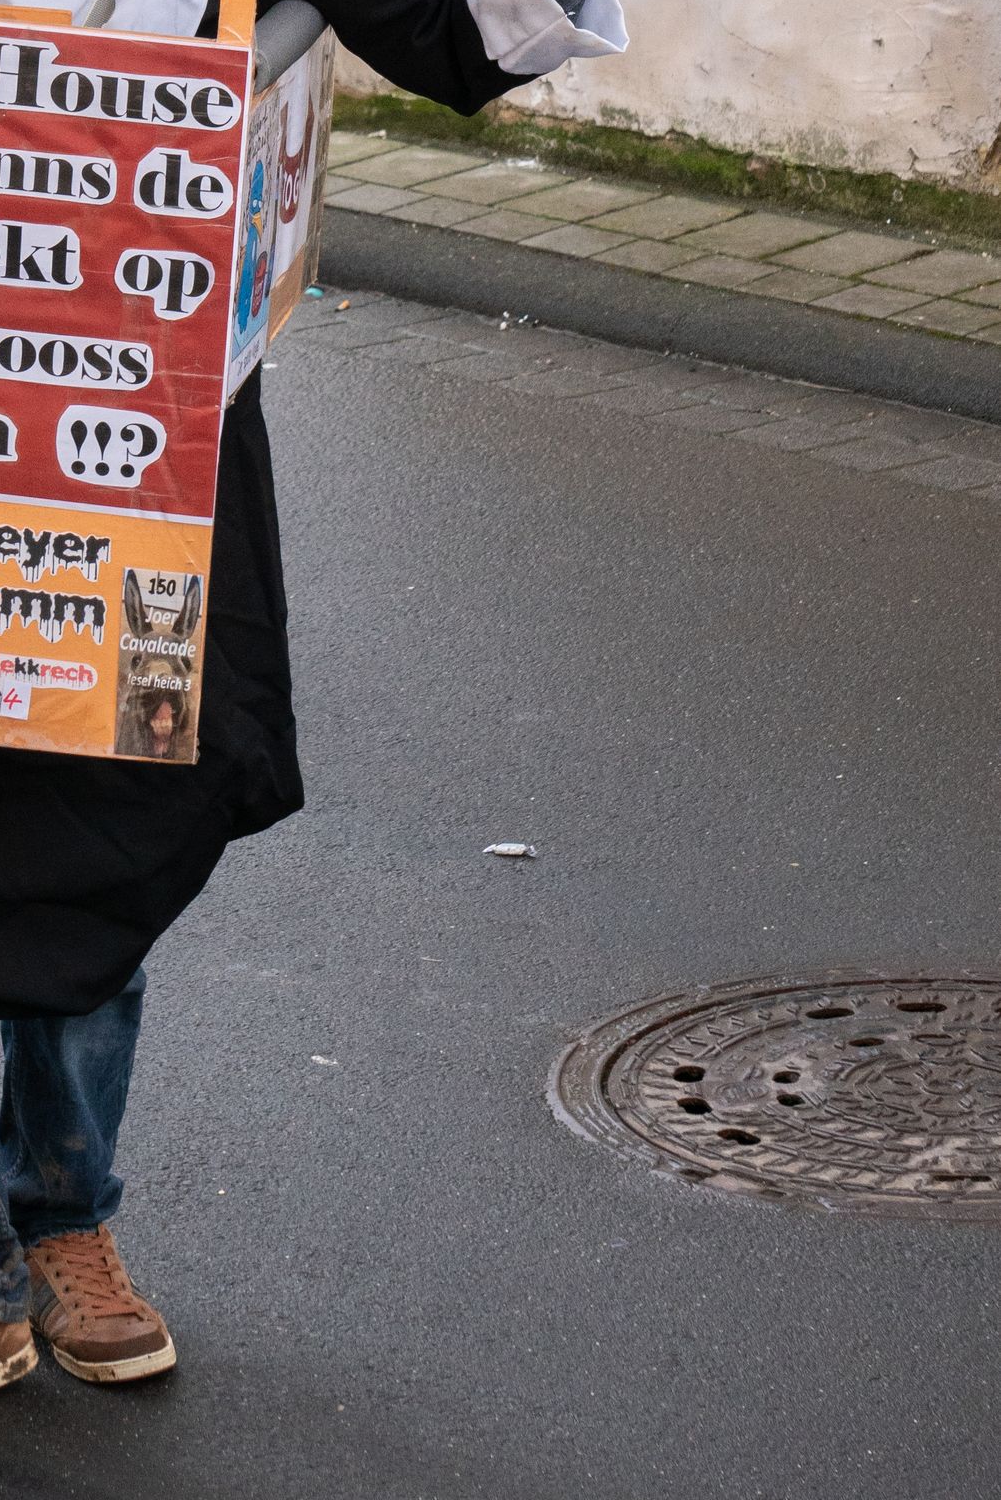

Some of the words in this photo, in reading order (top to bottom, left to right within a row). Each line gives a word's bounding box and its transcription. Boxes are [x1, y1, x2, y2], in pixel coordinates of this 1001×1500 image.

[139, 150, 226, 213] de
[122, 253, 209, 316] op
[68, 419, 158, 479] !!?
[148, 578, 177, 597] 150
[145, 606, 179, 625] Joer
[119, 633, 197, 658] Cavalcade
[153, 675, 183, 691] heich
[184, 678, 193, 691] 3
